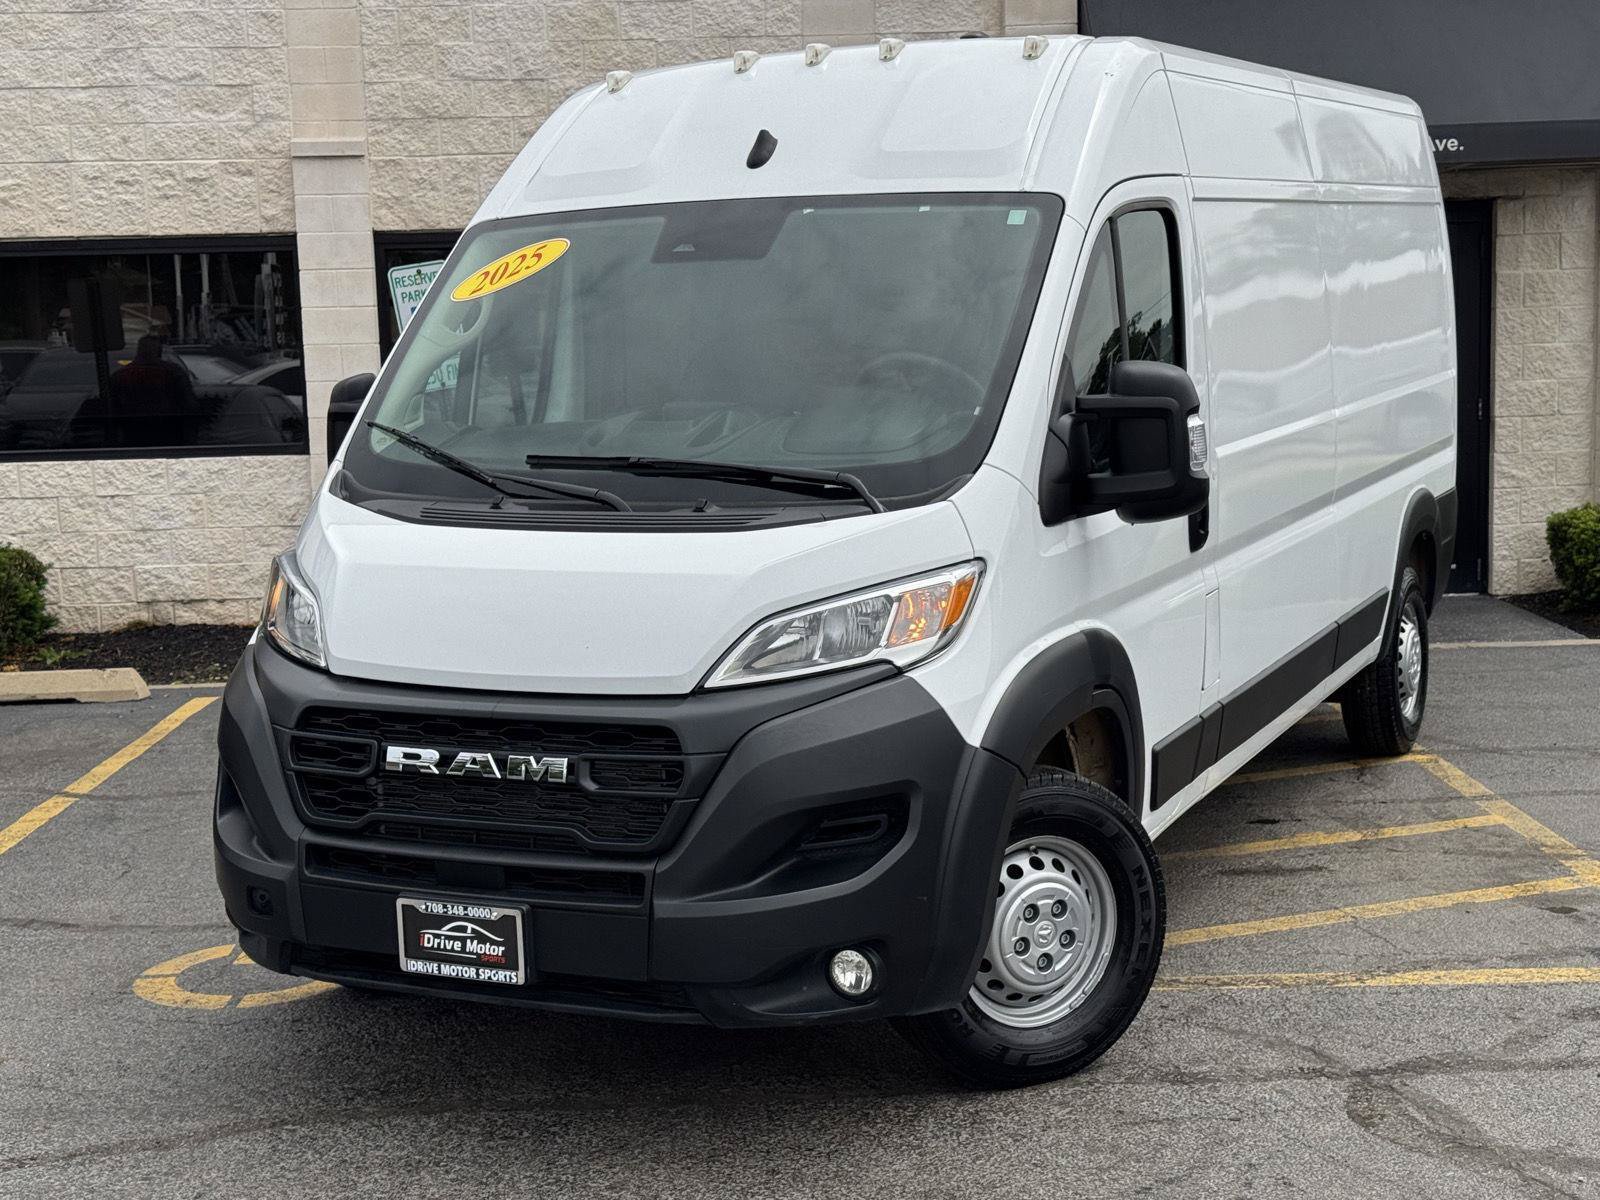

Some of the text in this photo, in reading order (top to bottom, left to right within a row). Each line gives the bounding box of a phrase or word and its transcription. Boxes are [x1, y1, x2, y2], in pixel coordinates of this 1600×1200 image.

[1431, 138, 1465, 152] ve.
[468, 244, 548, 296] 2025
[385, 745, 568, 784] RAM
[425, 902, 491, 918] 708-348-0000
[420, 932, 506, 957] iDrive Motor
[480, 954, 506, 964] SPORTS
[440, 964, 477, 979] MOTOR
[478, 970, 517, 984] SPORTS
